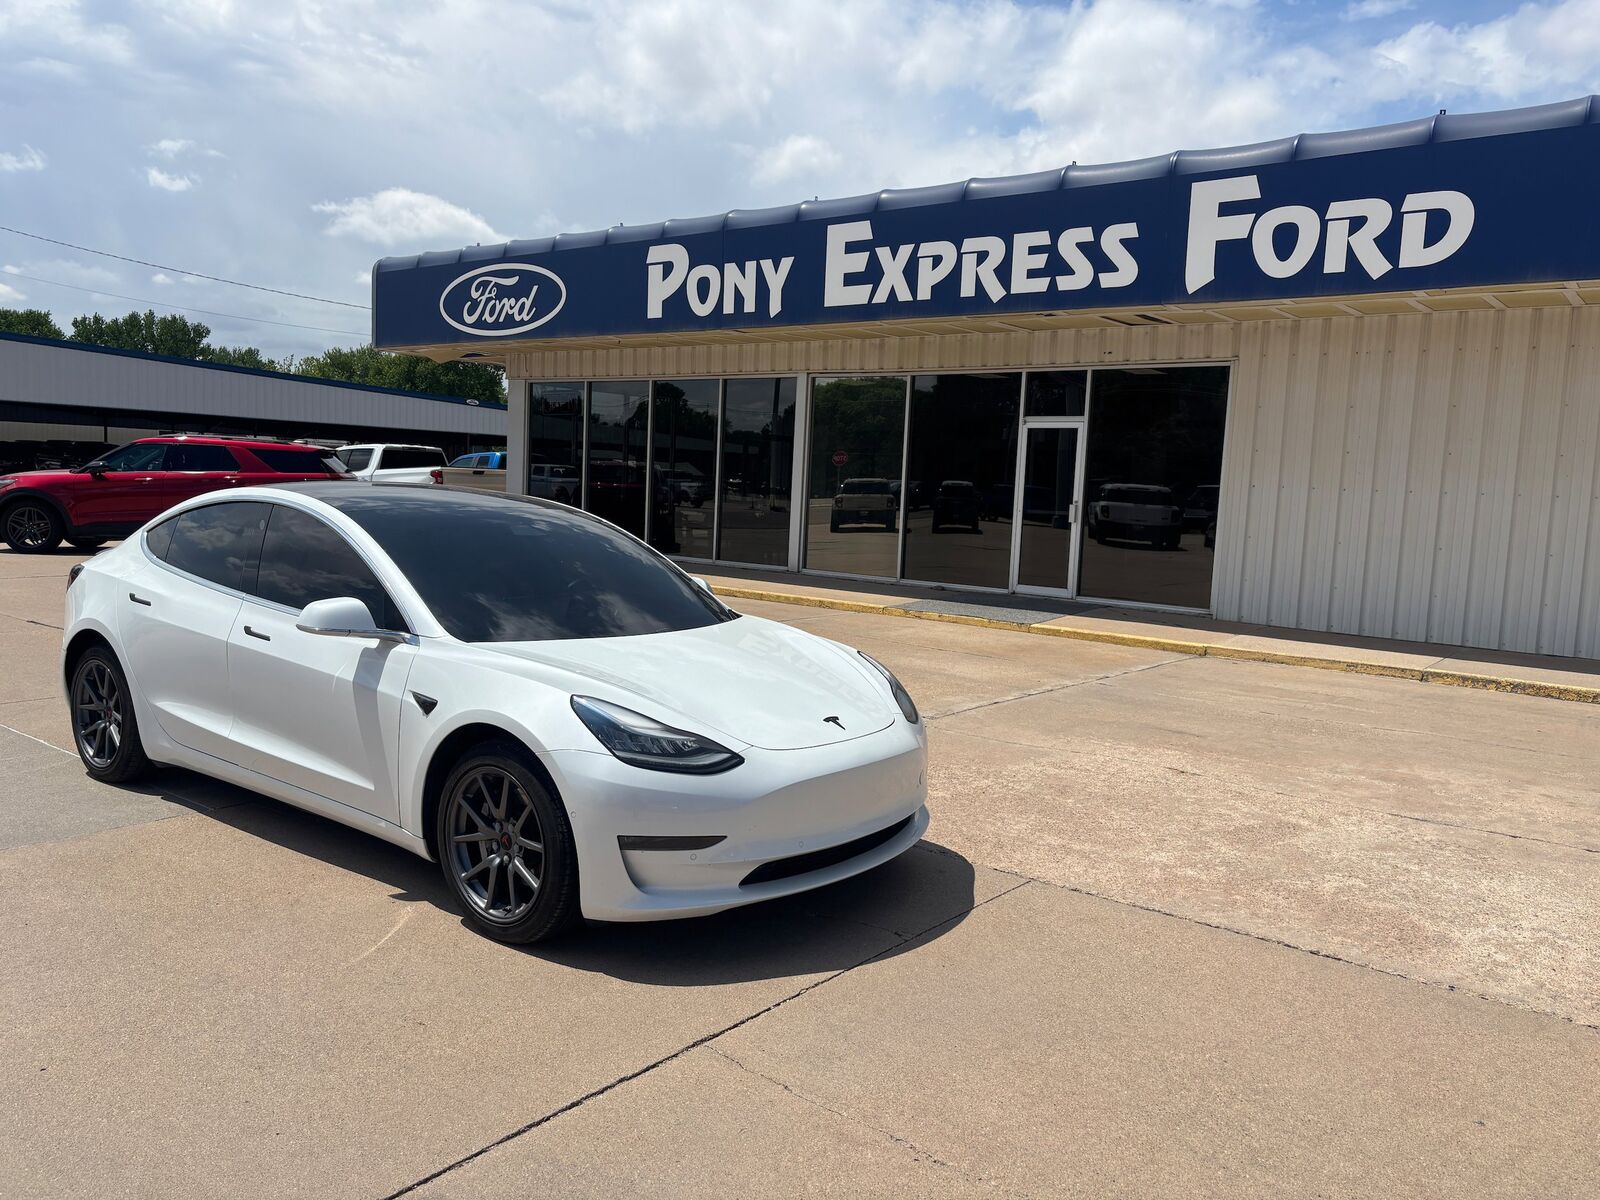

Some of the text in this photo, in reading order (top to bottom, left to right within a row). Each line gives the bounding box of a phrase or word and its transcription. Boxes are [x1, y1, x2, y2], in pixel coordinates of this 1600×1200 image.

[645, 174, 1475, 319] PONY EXPRESS FORD
[463, 275, 539, 324] Ford
